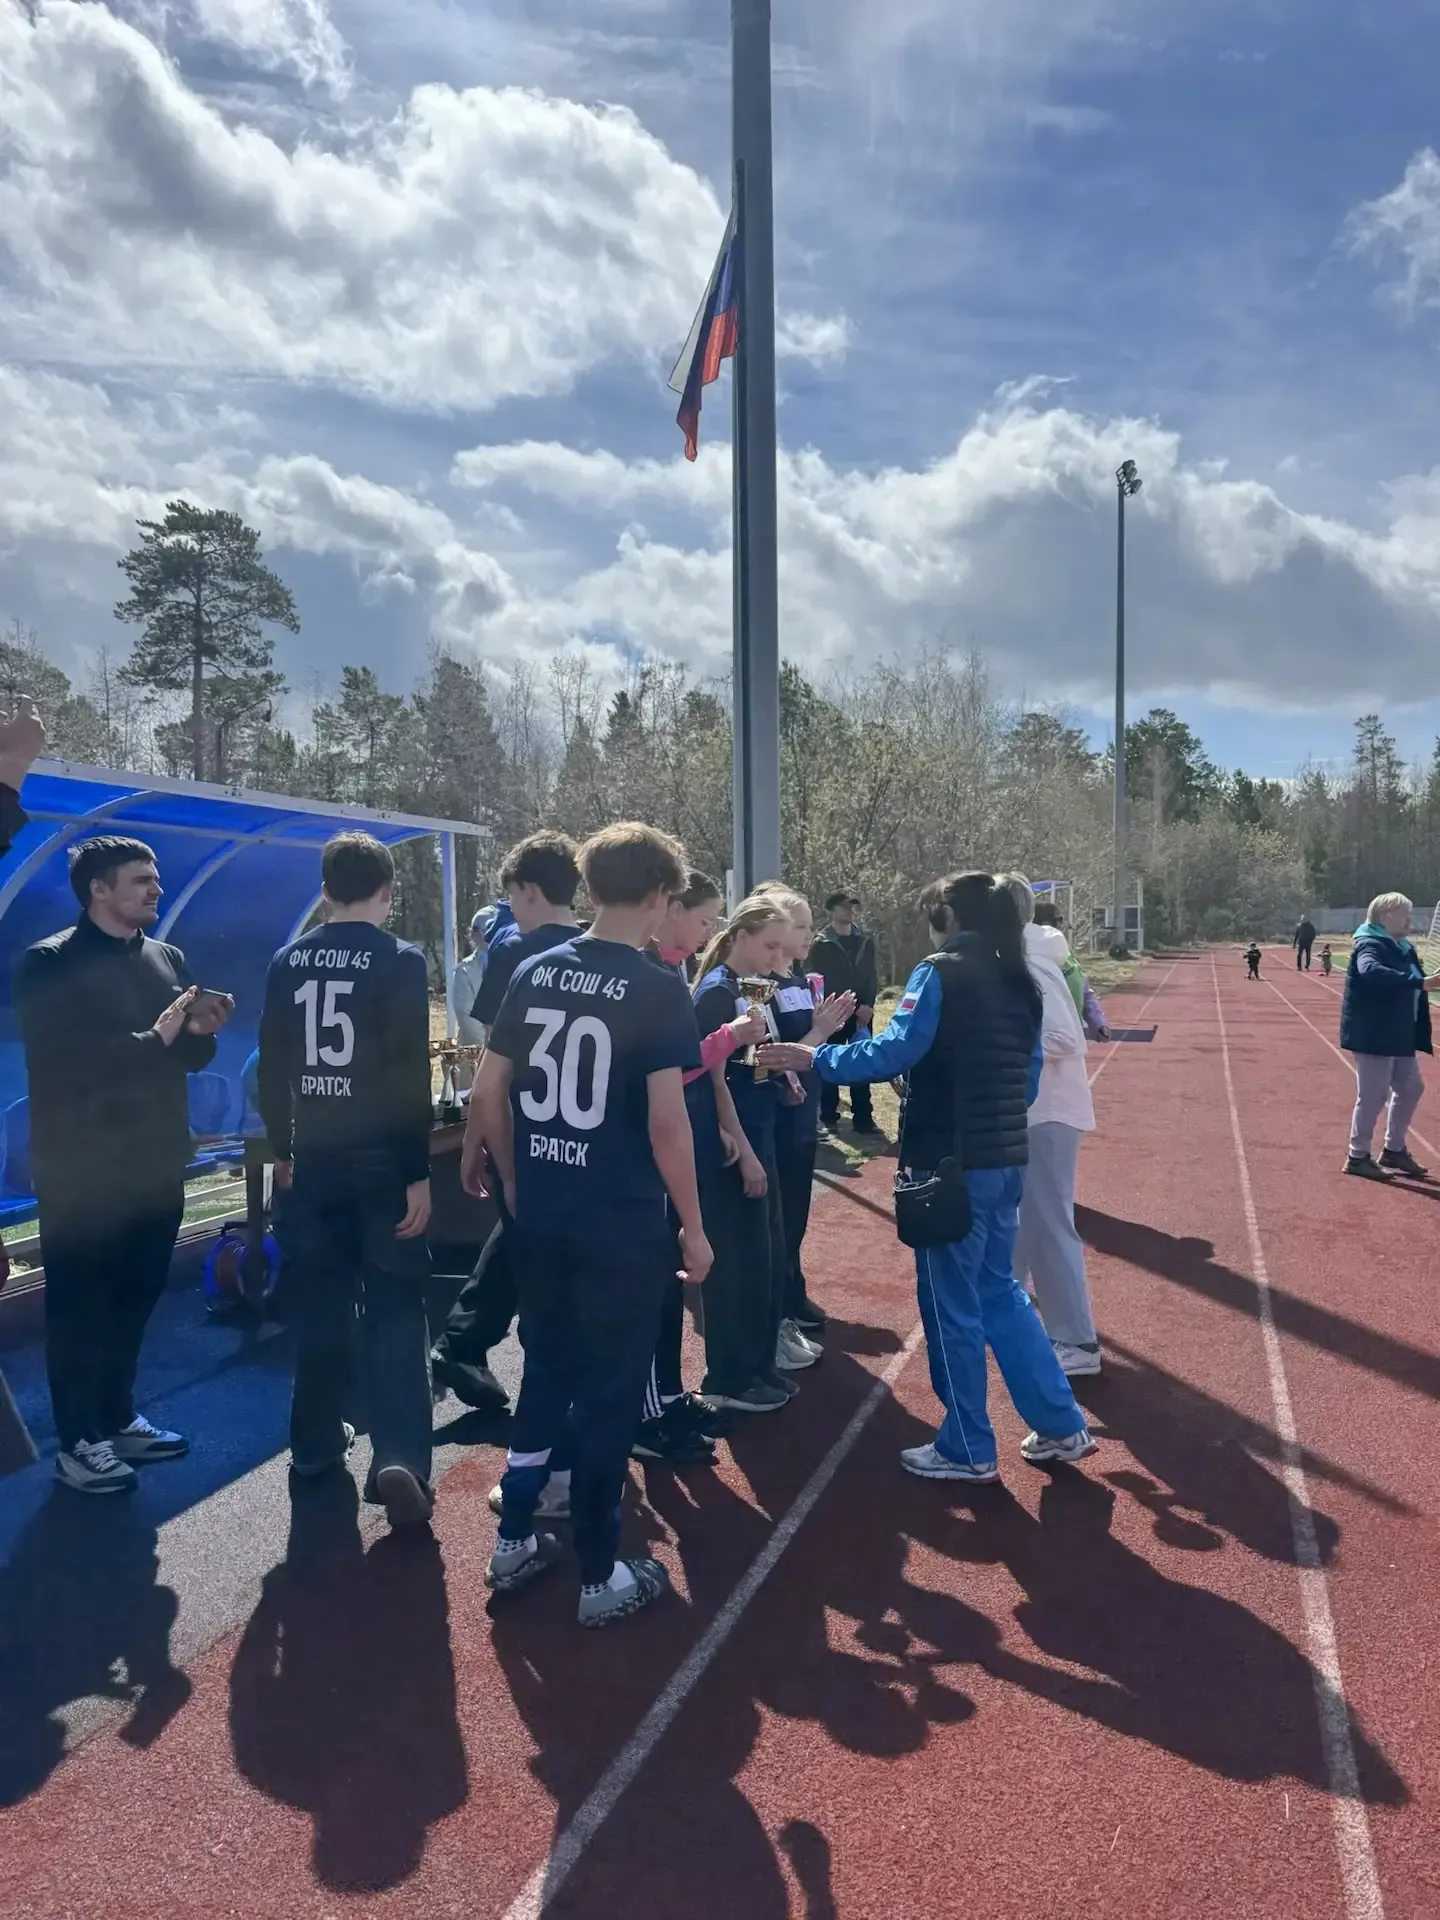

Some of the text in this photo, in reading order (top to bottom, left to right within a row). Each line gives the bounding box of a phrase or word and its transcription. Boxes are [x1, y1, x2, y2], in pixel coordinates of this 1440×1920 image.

[289, 949, 372, 970] ФК СОШ 45
[531, 965, 629, 1001] ФК СОШ 45
[294, 980, 355, 1067] 15
[301, 1075, 352, 1097] БРАТСК
[519, 1007, 612, 1131] 30
